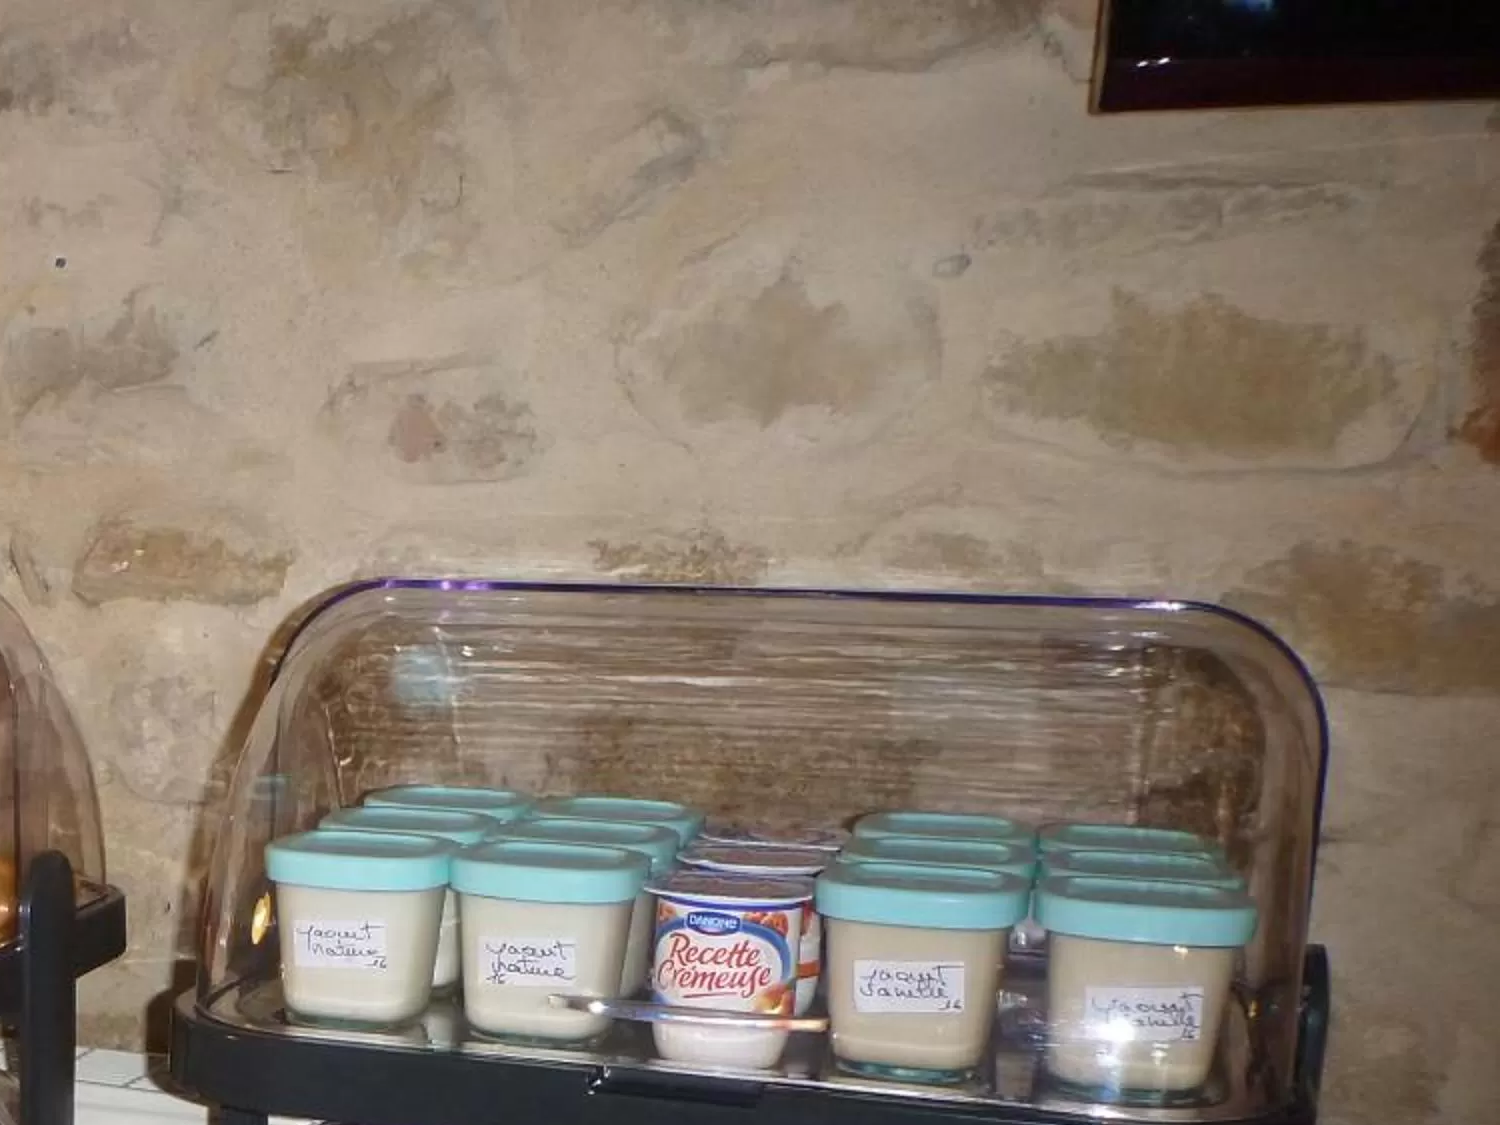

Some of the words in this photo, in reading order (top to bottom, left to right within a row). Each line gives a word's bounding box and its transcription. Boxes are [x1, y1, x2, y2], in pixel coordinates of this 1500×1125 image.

[689, 914, 738, 930] DANONE
[669, 932, 761, 967] Recette
[657, 959, 772, 998] Crémeuse
